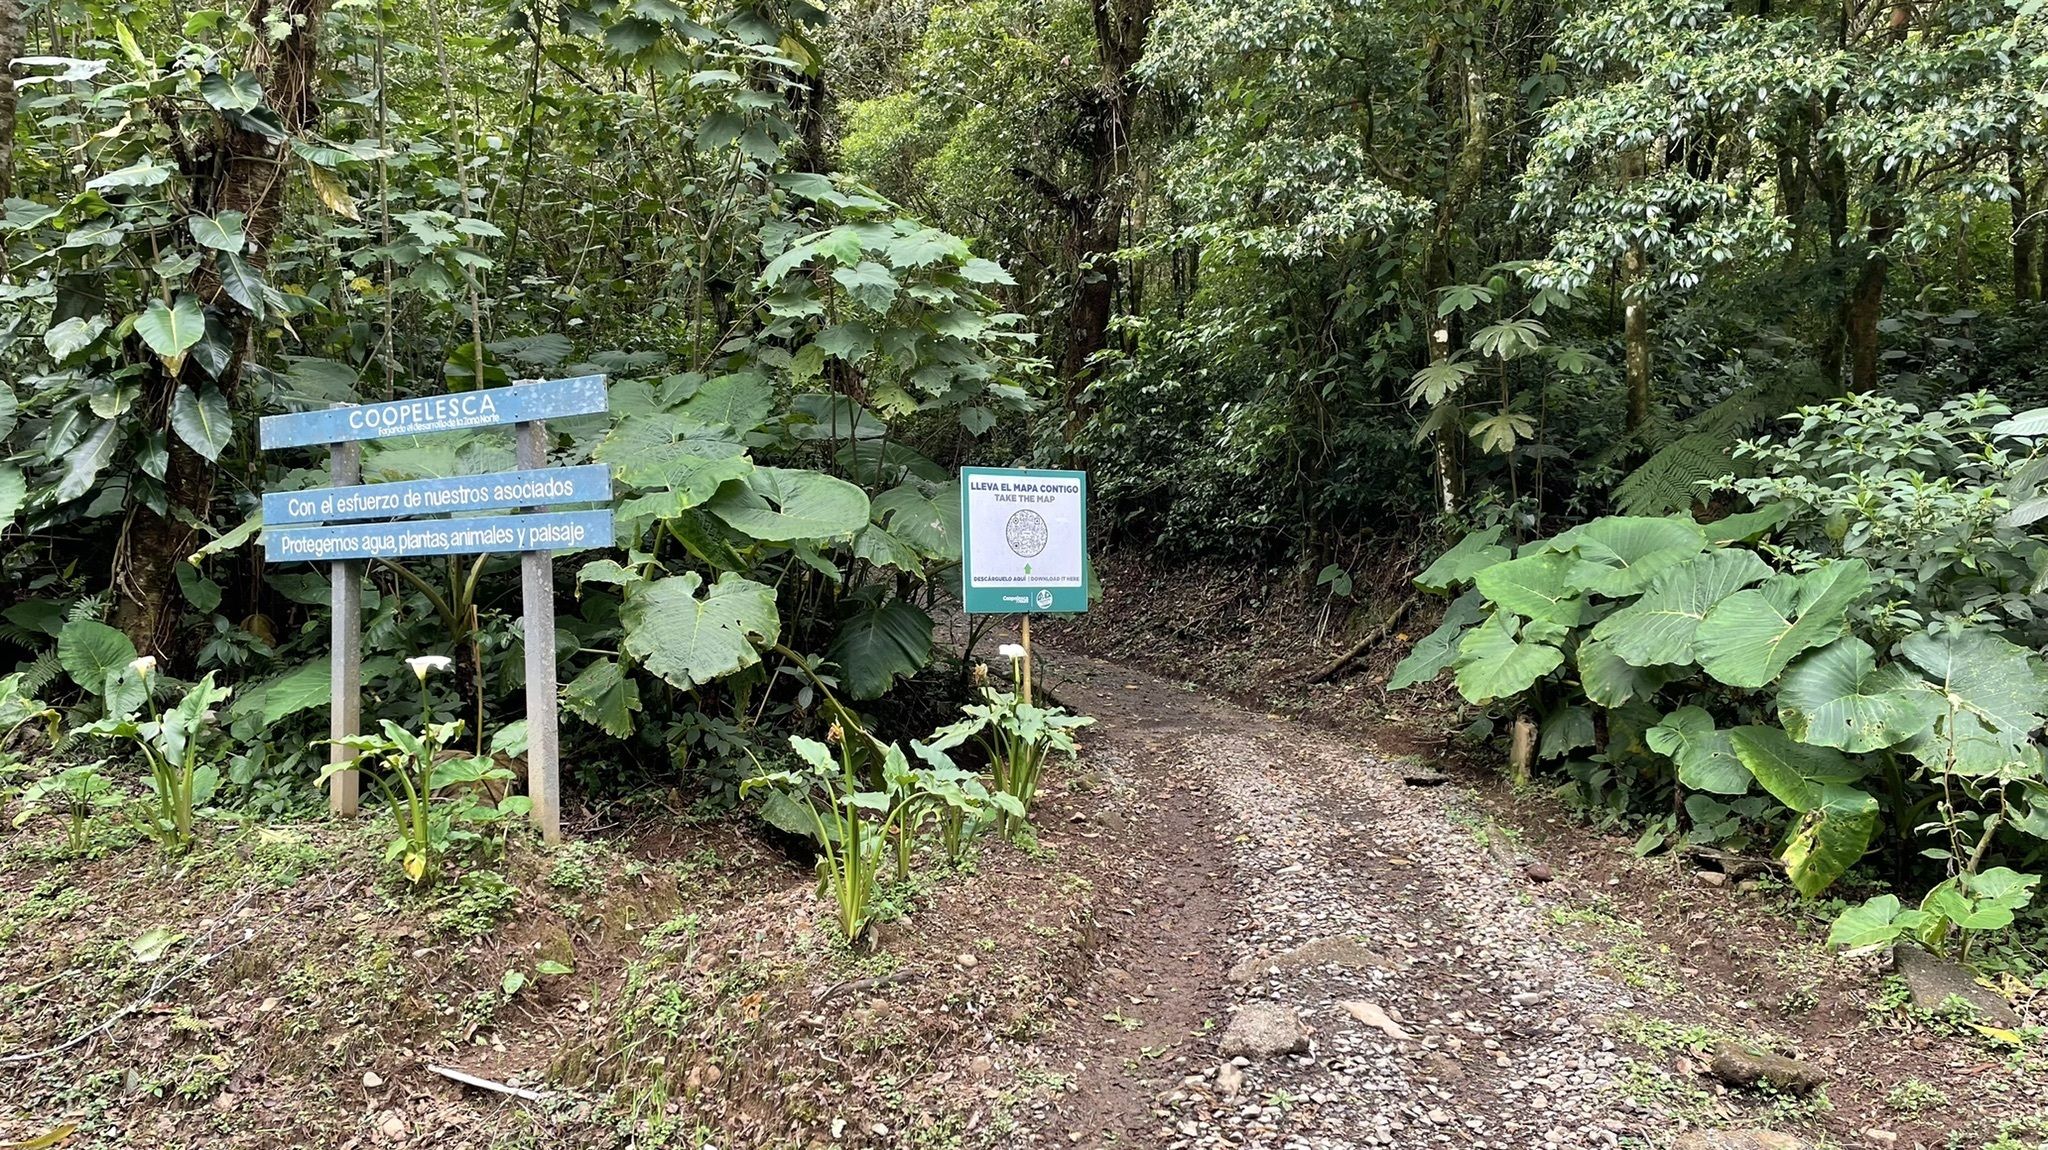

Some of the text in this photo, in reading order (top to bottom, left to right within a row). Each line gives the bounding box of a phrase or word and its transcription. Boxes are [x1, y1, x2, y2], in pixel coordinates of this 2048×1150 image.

[349, 394, 496, 429] COOPELESCA
[480, 413, 500, 424] Norte
[288, 477, 574, 516] Con el esfuerzo de nuestros asociados
[971, 482, 1078, 493] LLEVA EL MAPA CONTIGO
[994, 494, 1055, 503] TAKE THE MAP
[281, 535, 359, 557] Protegemos
[517, 527, 526, 549] y
[530, 522, 585, 547] paisaje
